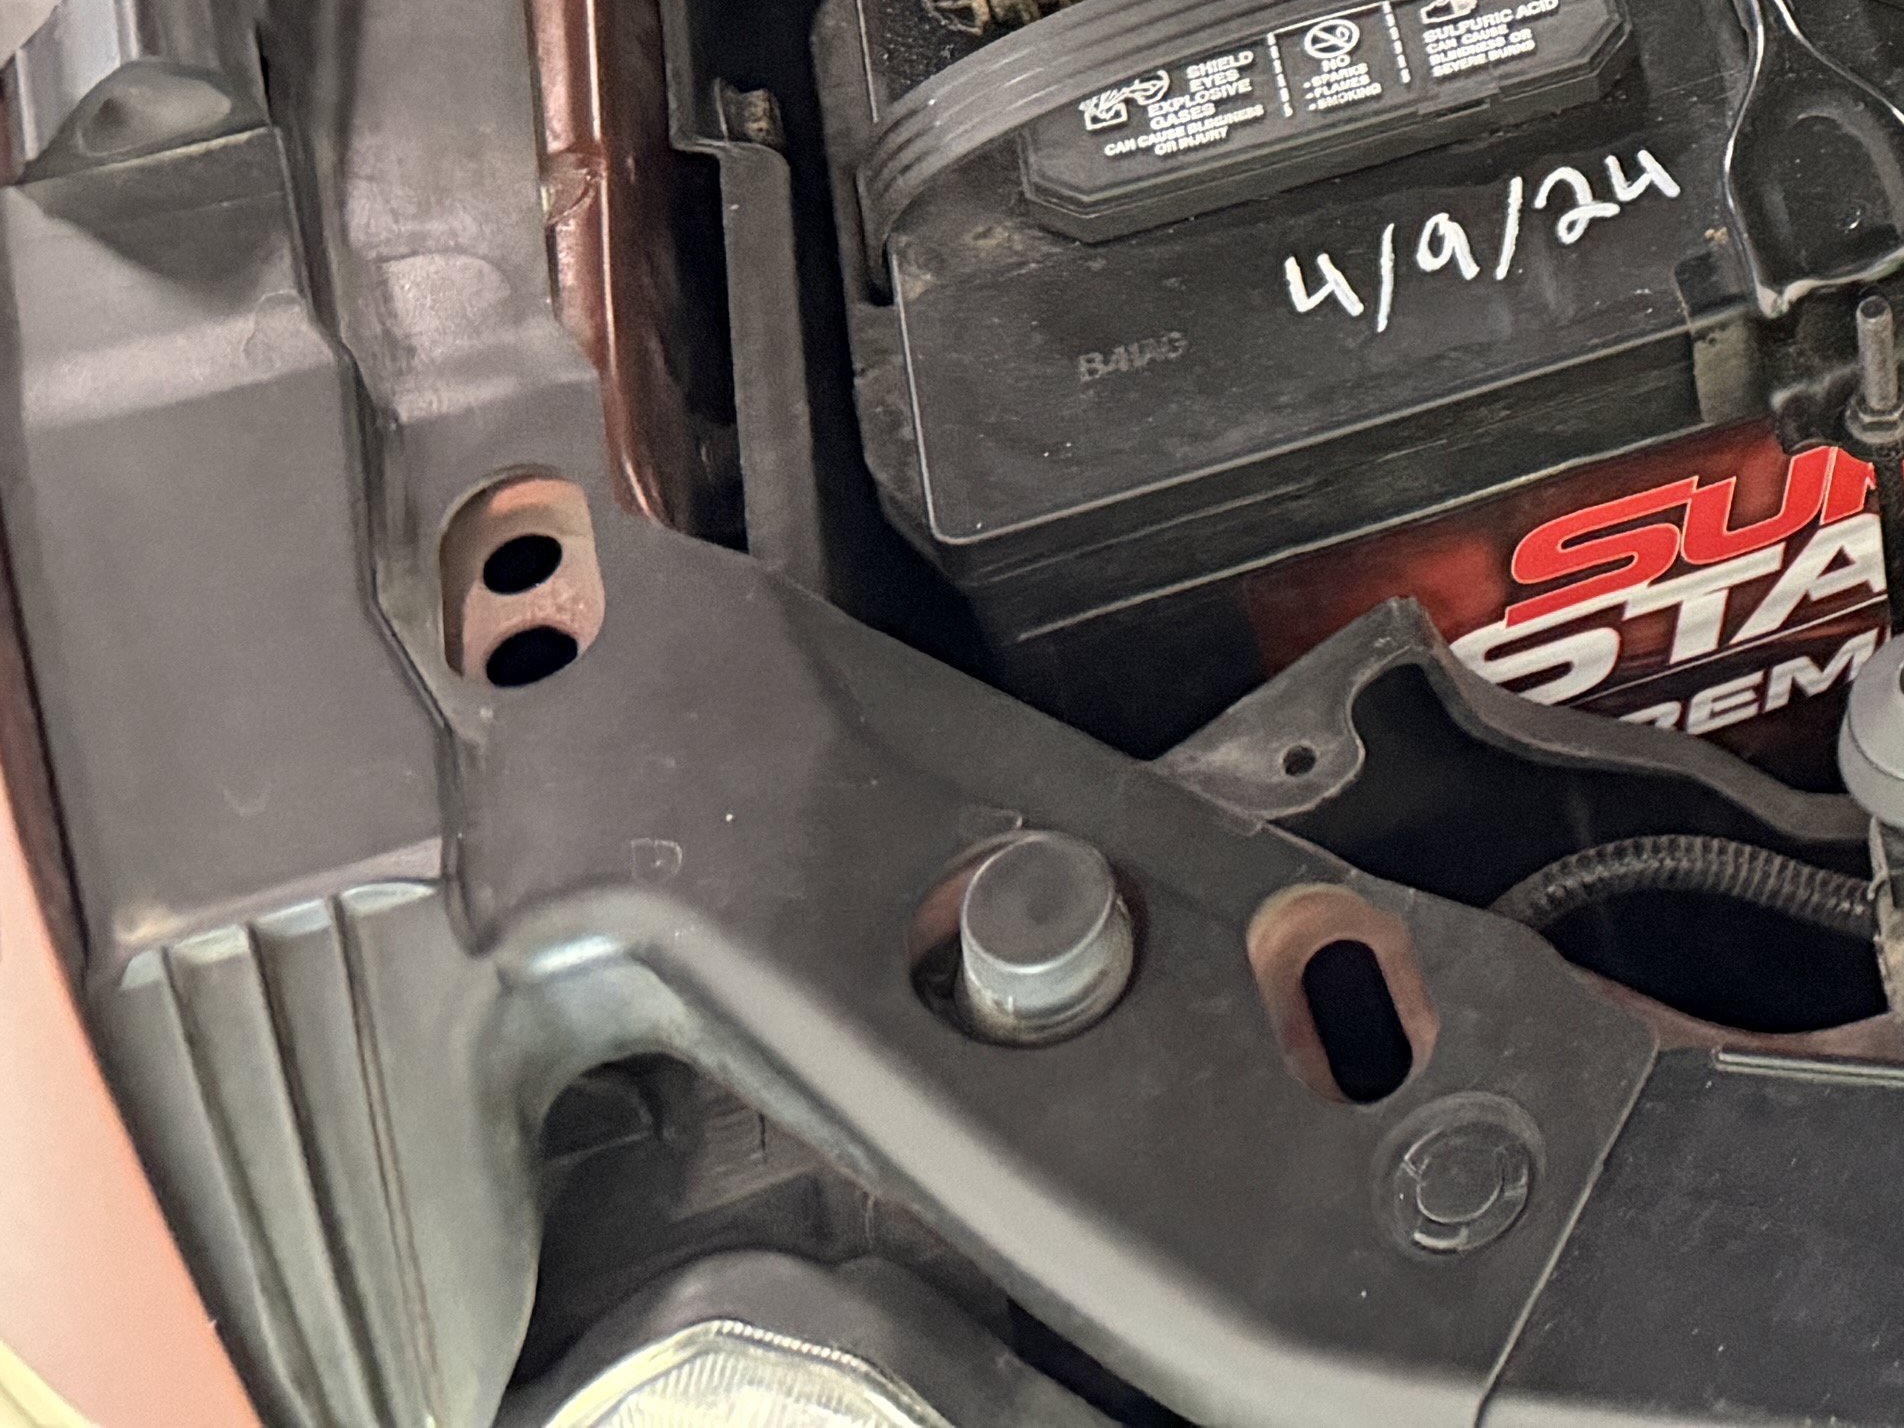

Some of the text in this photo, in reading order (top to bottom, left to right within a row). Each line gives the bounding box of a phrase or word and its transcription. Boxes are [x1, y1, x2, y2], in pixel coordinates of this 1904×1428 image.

[1422, 8, 1513, 44] SULFURIC
[1426, 24, 1509, 55] CAN CAUSE
[1322, 55, 1350, 72] NO
[1429, 28, 1533, 66] BLINDNESS OR
[1432, 40, 1536, 79] SEVERE BURNS
[1187, 50, 1254, 80] SHIELD
[1189, 68, 1240, 93] EYES
[1148, 77, 1253, 118] EXPLOSIVE
[1104, 104, 1265, 157] CAN CAUSE BLINDNESS
[1150, 102, 1216, 131] GASES
[1155, 126, 1229, 156] OR INJURY
[1284, 149, 1681, 332] 4/9/24
